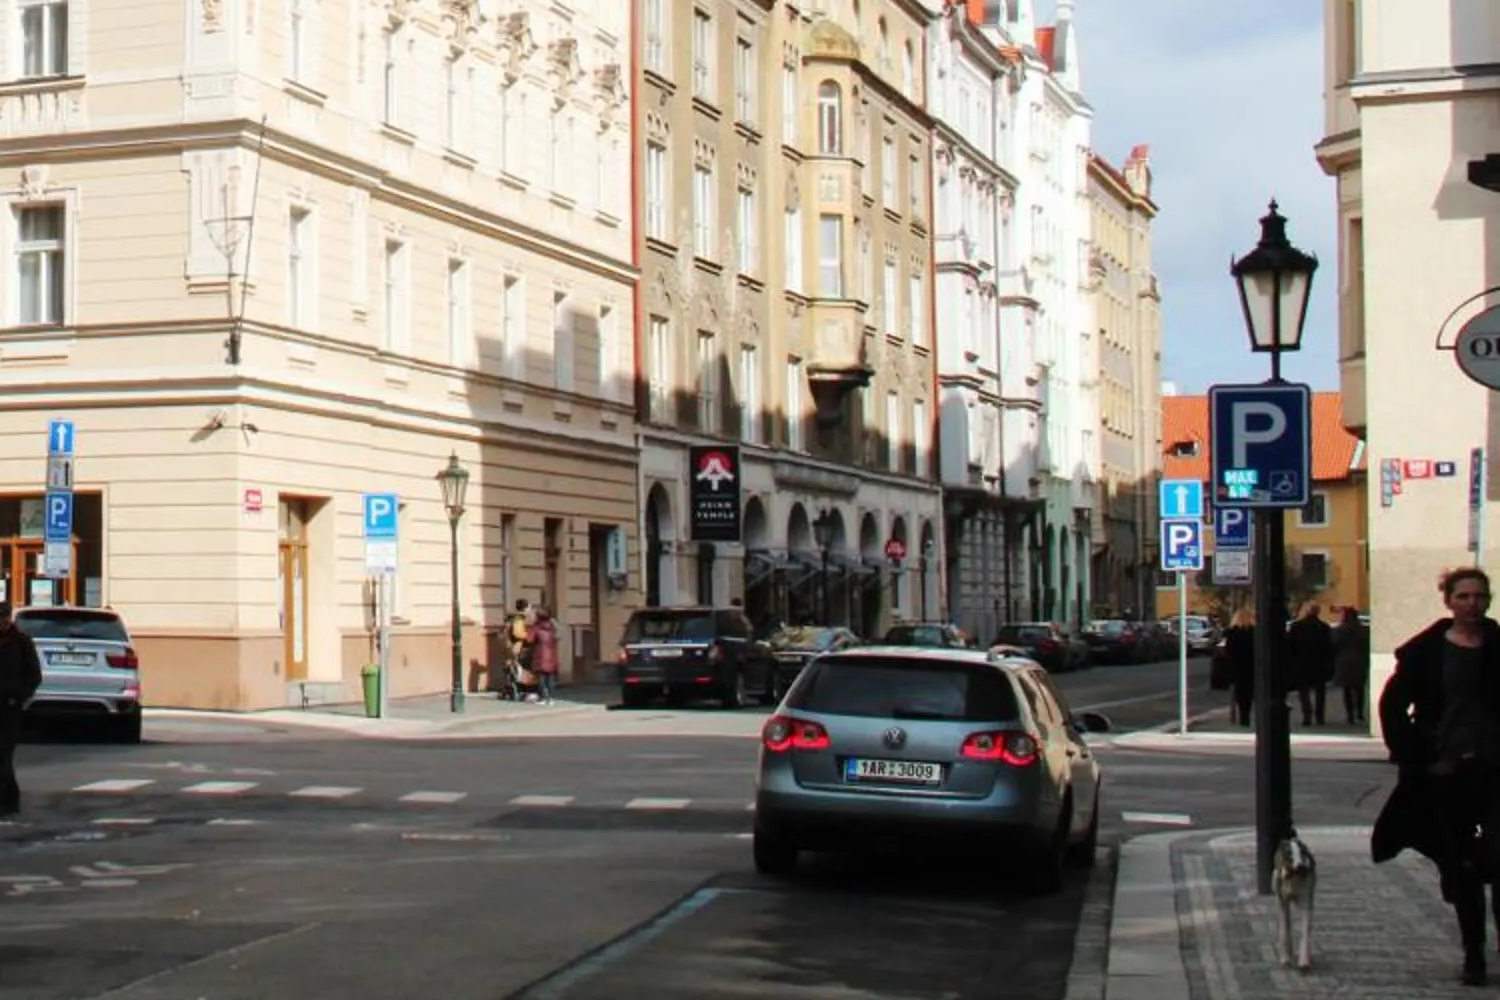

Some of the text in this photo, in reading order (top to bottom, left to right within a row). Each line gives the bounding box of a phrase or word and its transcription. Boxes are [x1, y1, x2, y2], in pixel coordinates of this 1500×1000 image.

[1232, 401, 1287, 468] P
[51, 498, 67, 525] P
[371, 498, 390, 525] P
[1220, 509, 1244, 535] P
[1169, 524, 1193, 555] P
